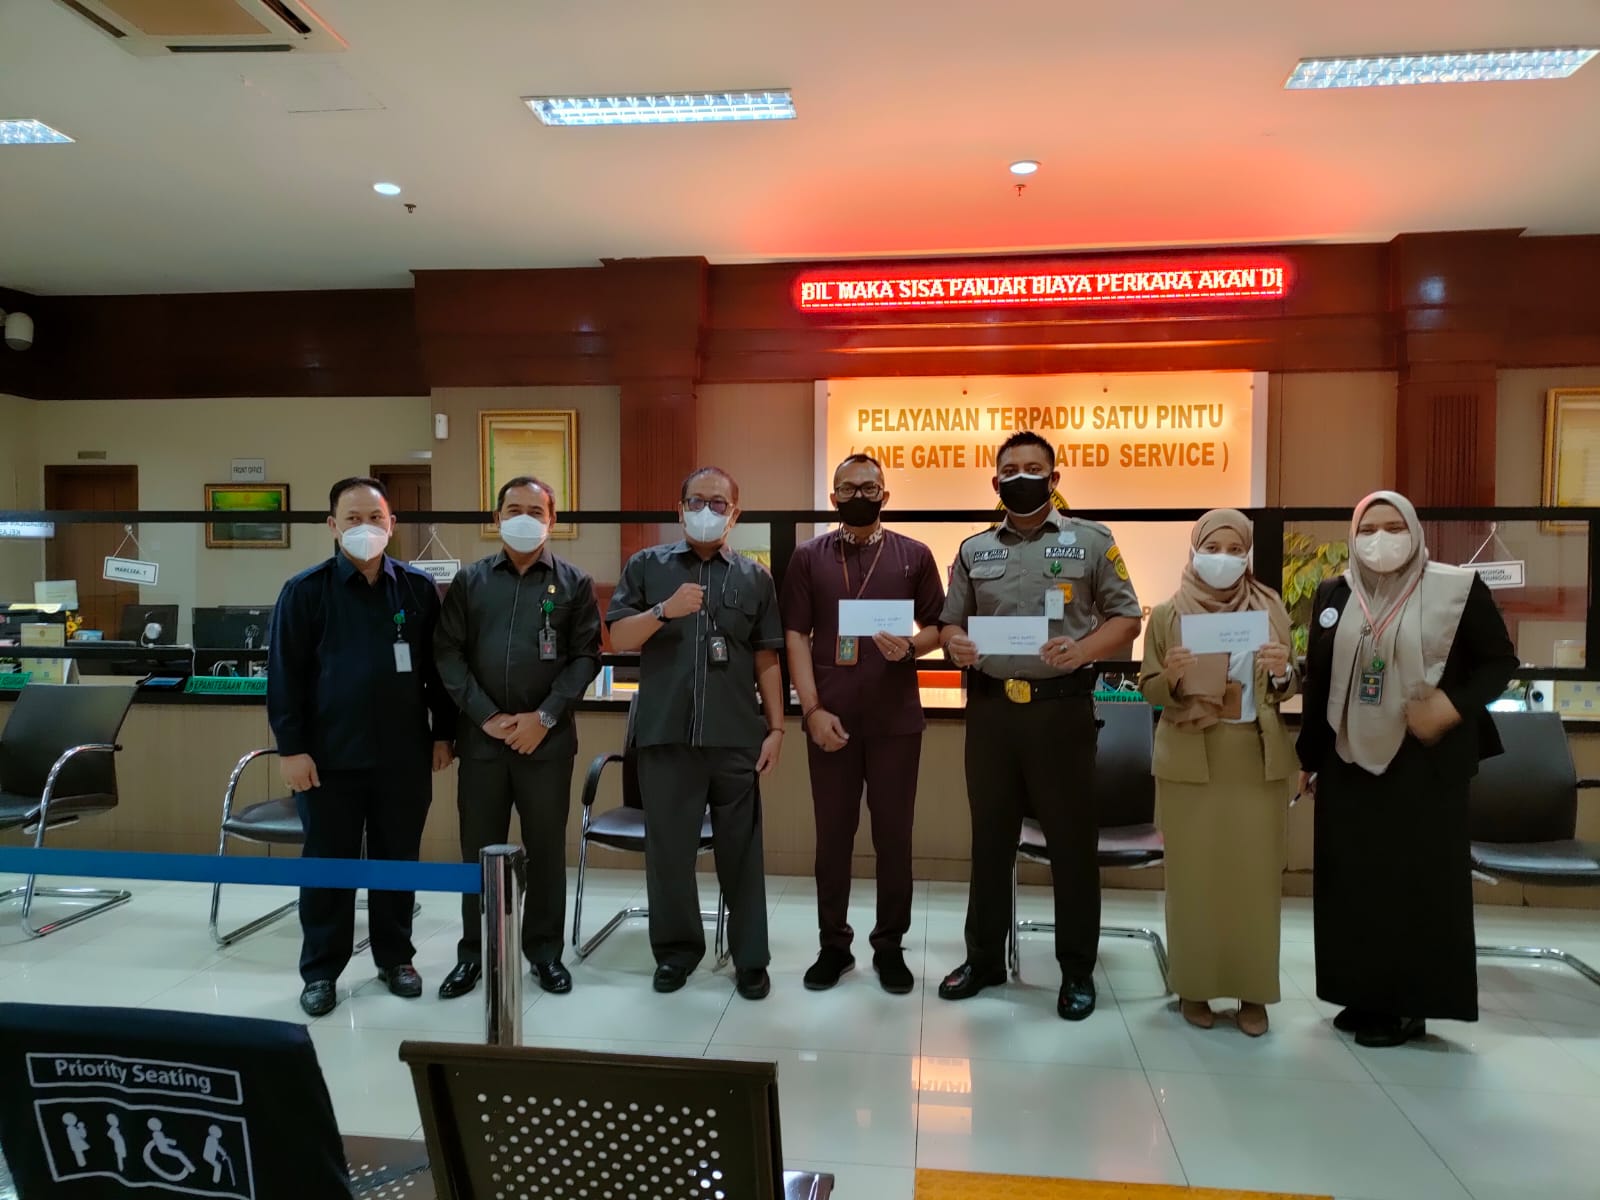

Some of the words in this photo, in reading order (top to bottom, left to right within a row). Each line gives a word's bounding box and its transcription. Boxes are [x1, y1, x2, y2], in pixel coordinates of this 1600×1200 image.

[838, 281, 894, 299] MAKA
[899, 279, 944, 297] SISA
[949, 277, 1026, 296] PANJAR
[1031, 275, 1091, 294] BIAYA
[1097, 273, 1193, 292] PERKARA
[1198, 270, 1255, 289] AKAN
[858, 408, 978, 432] PELAYANAN
[986, 406, 1084, 430] TERPADU
[1093, 405, 1148, 429] SATU
[1156, 403, 1224, 428] PINTU
[911, 445, 966, 468] GATE
[1119, 443, 1215, 467] SERVICE
[55, 1059, 127, 1084] Priority
[133, 1064, 212, 1094] Seating
